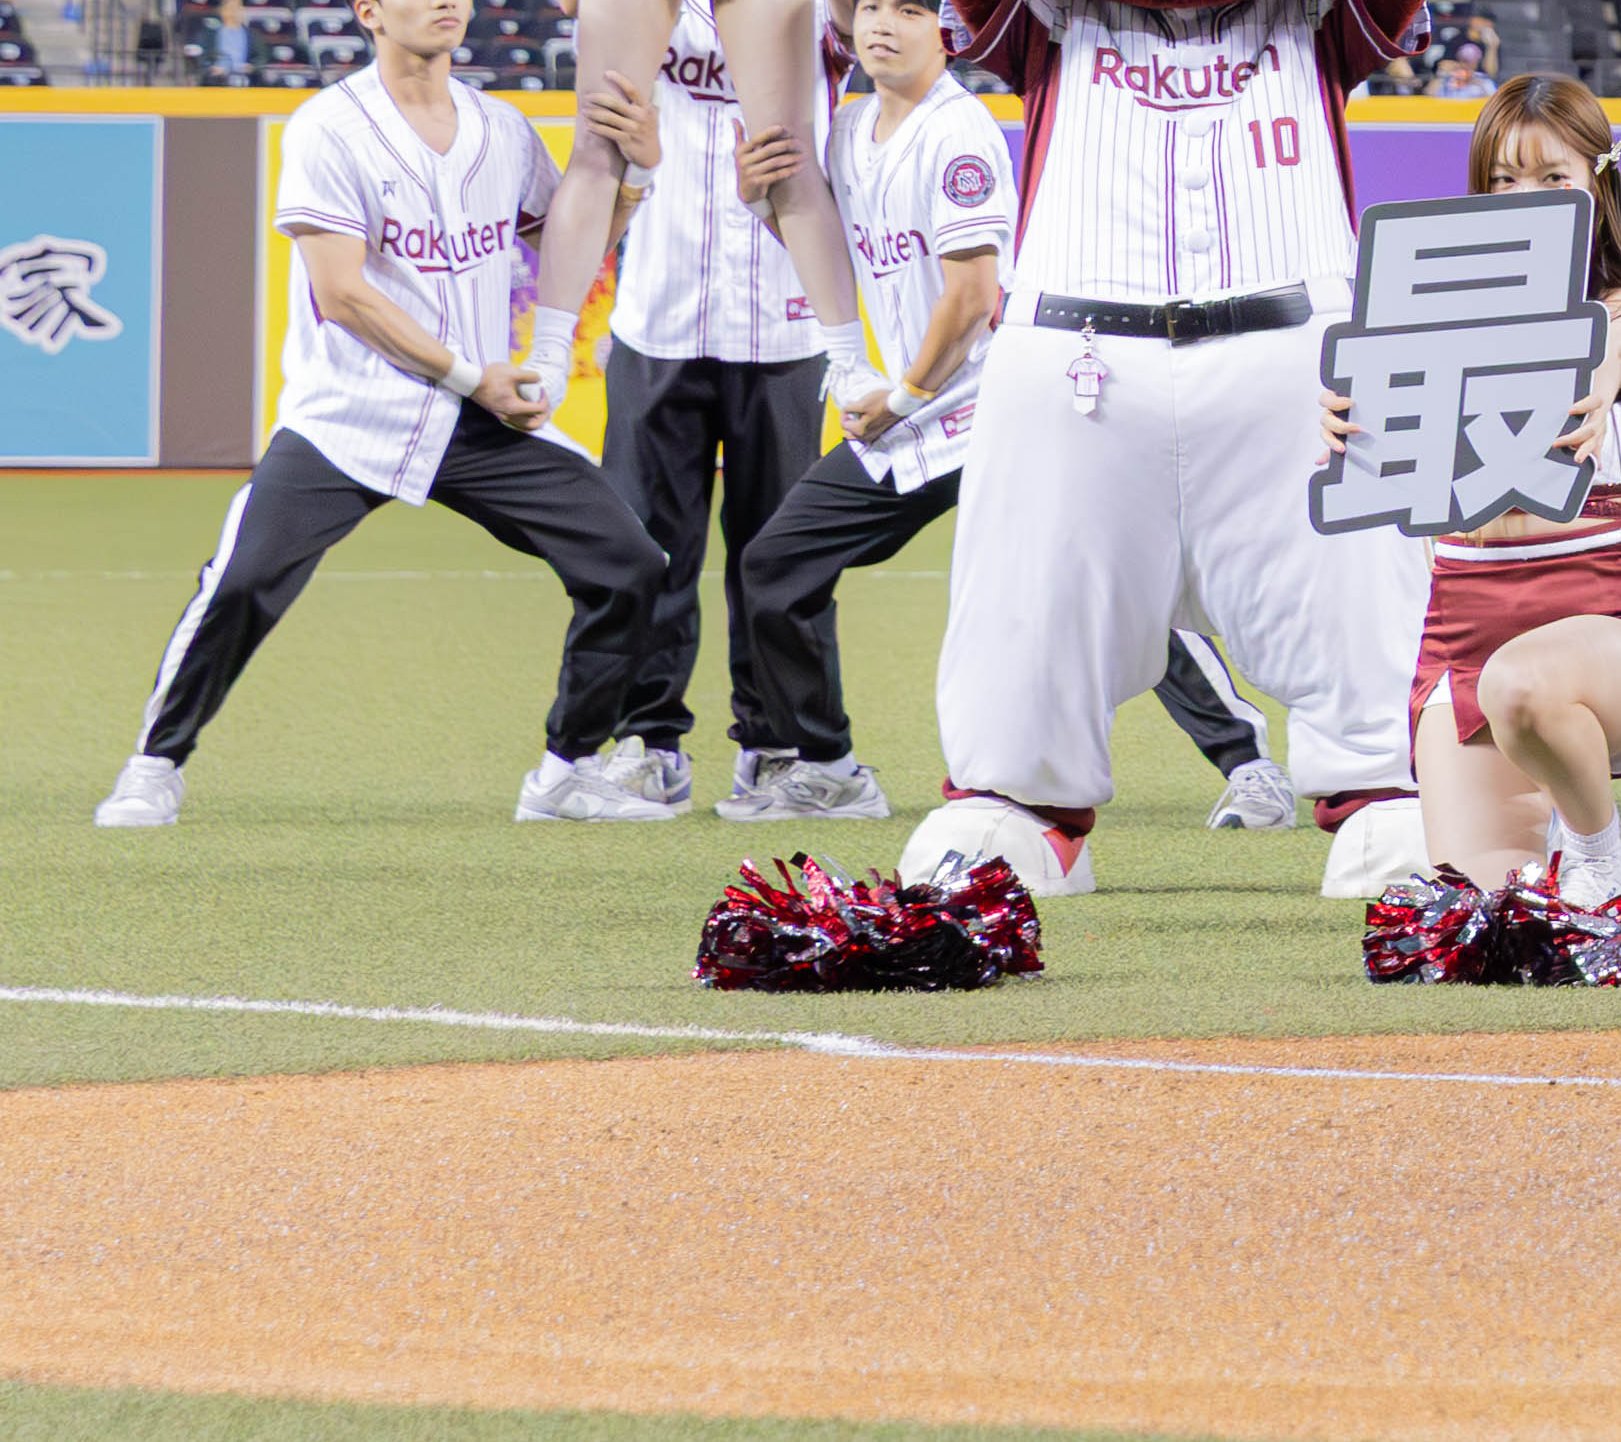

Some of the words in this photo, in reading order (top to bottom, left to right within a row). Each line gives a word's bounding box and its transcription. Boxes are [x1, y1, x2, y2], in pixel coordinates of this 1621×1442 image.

[1093, 43, 1281, 113] Rakuten
[1248, 116, 1301, 168] 10
[1320, 203, 1596, 526] 最
